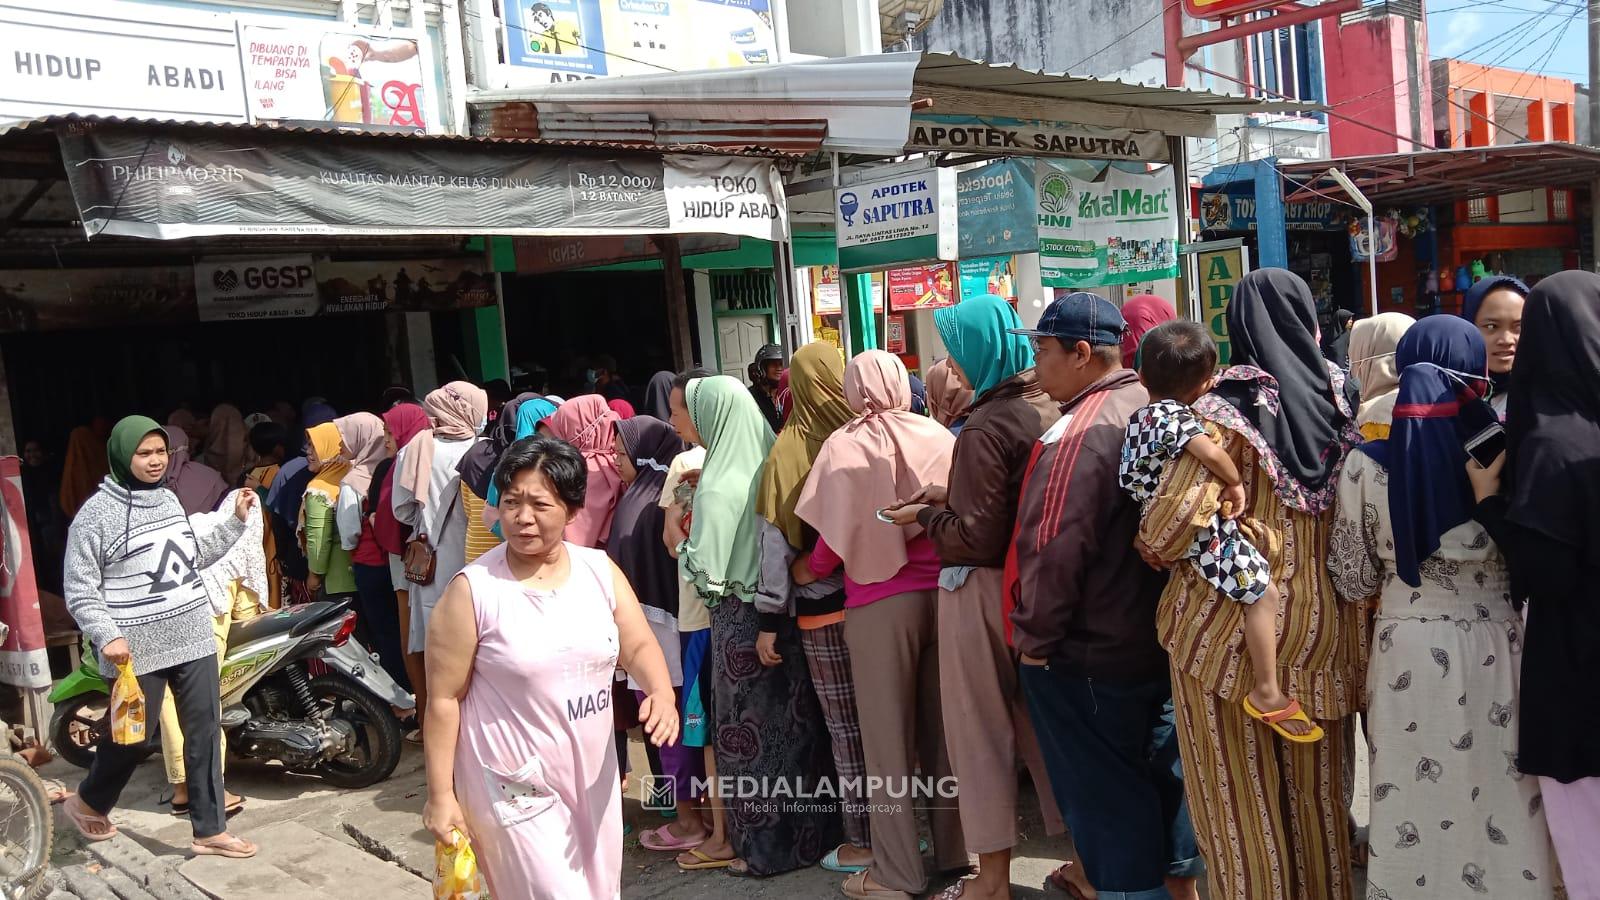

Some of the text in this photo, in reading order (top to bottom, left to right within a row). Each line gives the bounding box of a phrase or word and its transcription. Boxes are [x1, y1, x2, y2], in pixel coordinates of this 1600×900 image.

[249, 42, 307, 56] DIBUANG DI
[15, 51, 225, 91] HIDUP ABADI
[251, 55, 310, 68] TEMPATNYA
[275, 69, 297, 79] BISA
[254, 80, 285, 92] ILANG
[912, 127, 1140, 157] APOTEK SAPUTRA
[319, 171, 532, 190] KUALITAS MANTAP KELAS DUNIA
[577, 172, 596, 190] Rp
[710, 175, 757, 194] TOKO
[871, 180, 928, 200] APOTEK
[580, 191, 597, 201] 12
[683, 201, 779, 220] HIDUP ABAD
[863, 197, 935, 225] SAPUTRA
[1284, 202, 1303, 219] ABY
[1304, 200, 1331, 219] SHOP
[1037, 214, 1072, 228] HNI
[244, 265, 312, 290] GGSP
